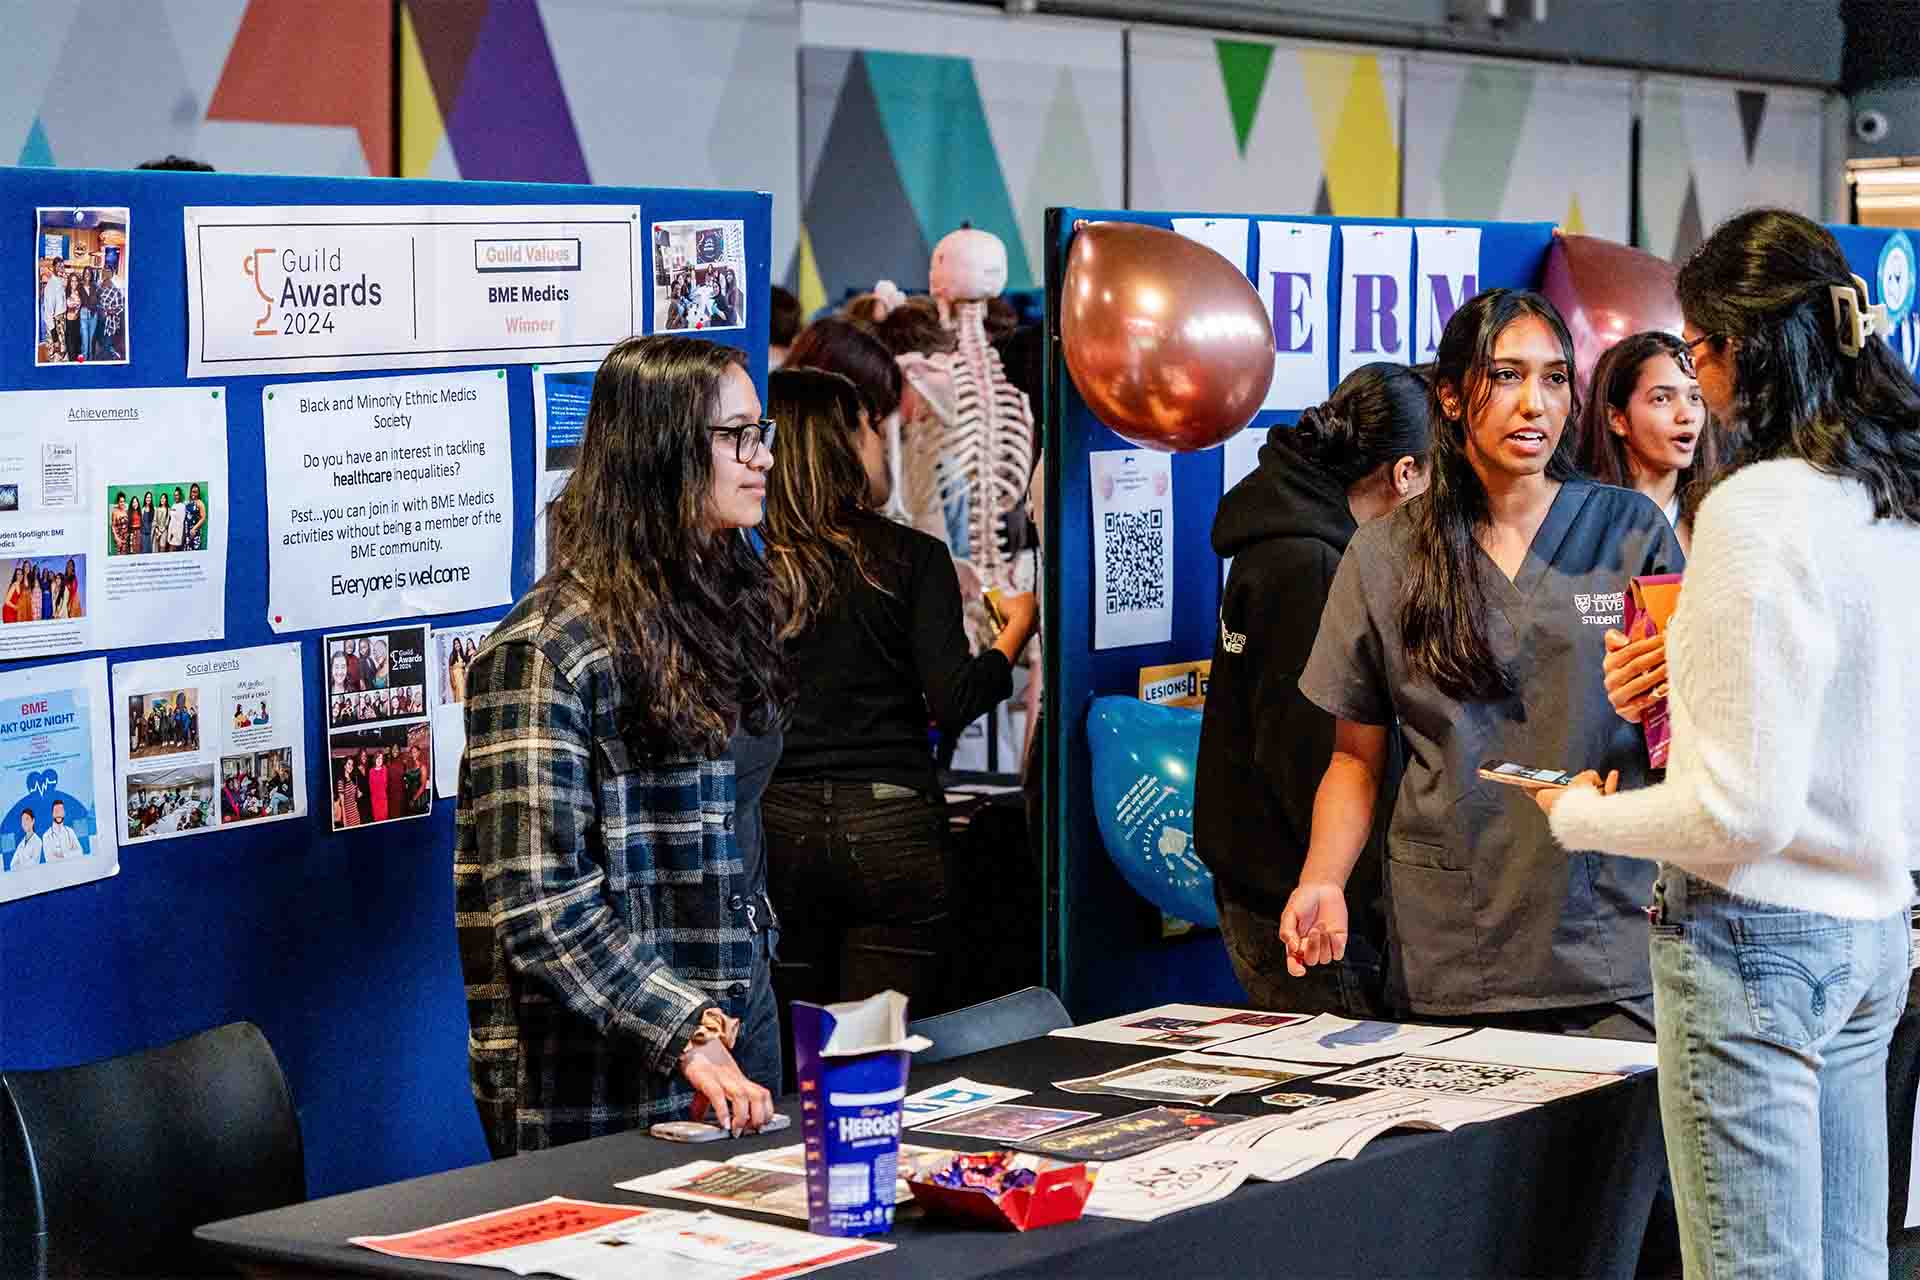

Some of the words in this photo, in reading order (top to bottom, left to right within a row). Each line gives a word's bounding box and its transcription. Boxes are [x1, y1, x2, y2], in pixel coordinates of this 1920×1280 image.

[282, 248, 342, 272] Guild
[486, 246, 521, 263] Guild
[527, 246, 570, 262] Values
[280, 273, 382, 308] Awards
[488, 287, 519, 303] BME
[522, 284, 569, 302] Medics
[283, 312, 335, 335] 2024
[505, 317, 555, 333] Winner
[300, 397, 330, 413] Black
[333, 395, 354, 411] and
[357, 393, 402, 409] Minority
[405, 390, 438, 405] Ethnic
[440, 387, 477, 403] Medics
[68, 407, 139, 419] Achievements
[374, 413, 412, 429] Society
[303, 454, 320, 468] Do
[322, 455, 343, 470] you
[346, 449, 372, 464] have
[375, 450, 388, 462] an
[391, 444, 431, 461] interest
[434, 443, 444, 457] in
[446, 440, 486, 456] tackling
[333, 468, 392, 487] healthcare
[394, 461, 461, 483] inequalities?
[291, 508, 344, 524] Psst...you
[347, 505, 366, 518] can
[368, 501, 389, 520] join
[391, 499, 400, 513] in
[402, 496, 428, 512] with
[431, 494, 455, 509] BME
[458, 490, 494, 506] Medics
[283, 527, 334, 545] activities
[337, 522, 380, 540] without
[383, 520, 412, 536] being
[415, 521, 422, 532] a
[425, 513, 469, 530] member
[472, 510, 483, 525] of
[484, 509, 502, 524] the
[350, 543, 377, 559] BME
[379, 536, 443, 556] community.
[331, 574, 393, 598] Everyone
[394, 567, 406, 588] is
[408, 564, 470, 587] welcome
[1594, 599, 1625, 612] LIVE
[1581, 614, 1622, 625] STUDENT
[186, 660, 212, 674] Social
[213, 659, 240, 672] events
[398, 654, 423, 664] Awards
[21, 701, 49, 716] BME
[0, 722, 18, 735] AKT
[20, 718, 42, 731] QUIZ
[44, 712, 75, 726] NIGHT
[838, 1111, 899, 1143] HEROES
